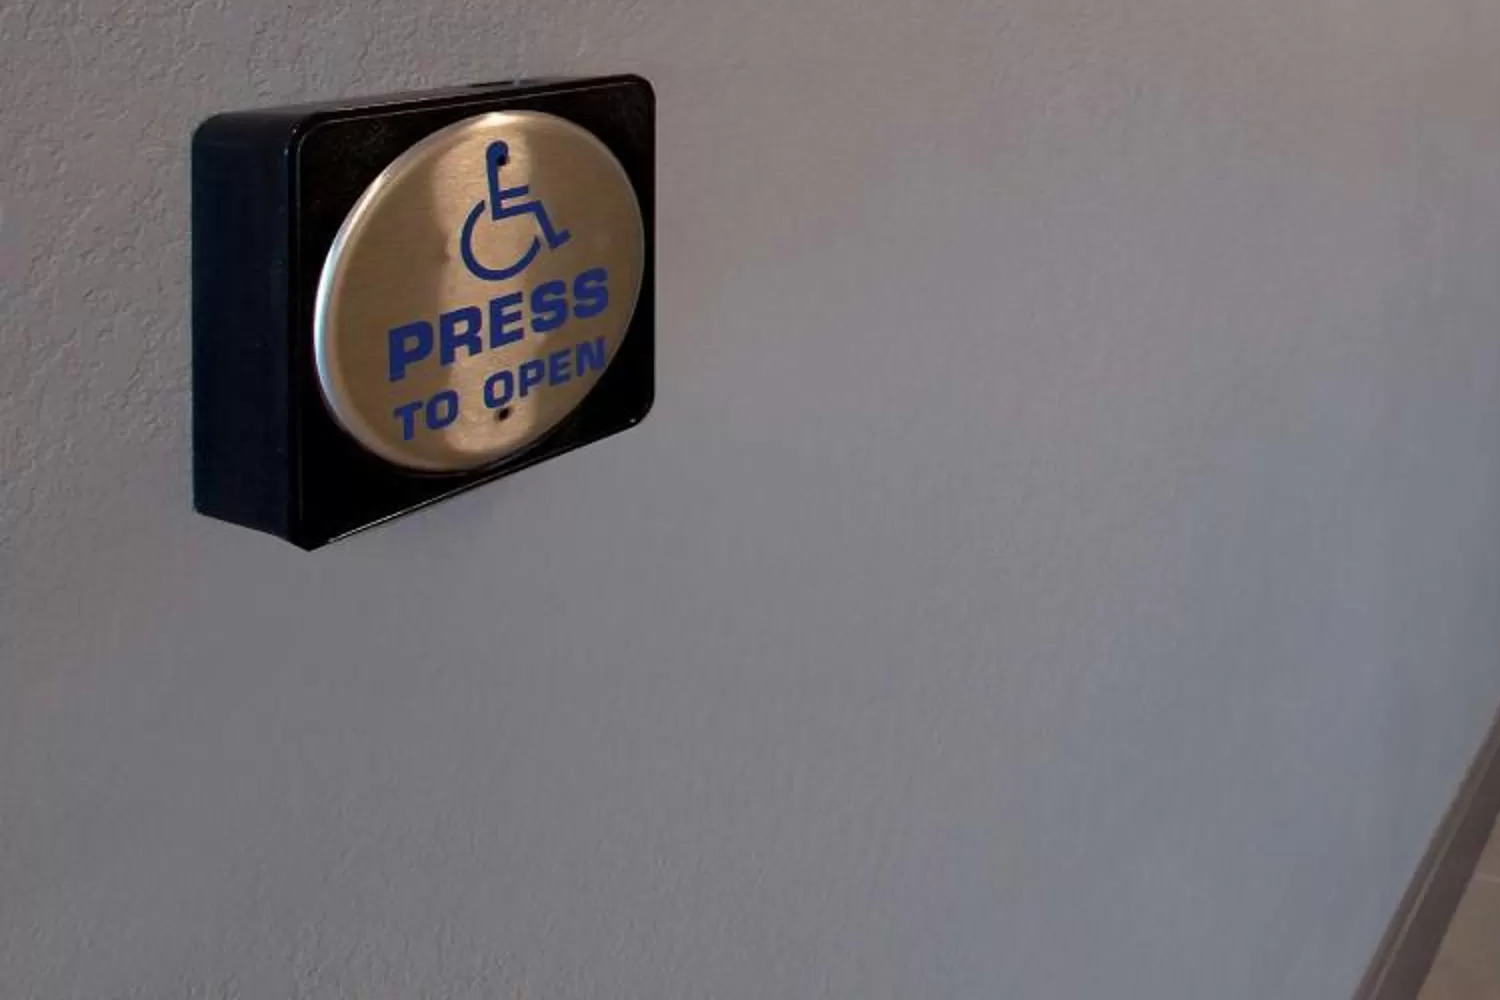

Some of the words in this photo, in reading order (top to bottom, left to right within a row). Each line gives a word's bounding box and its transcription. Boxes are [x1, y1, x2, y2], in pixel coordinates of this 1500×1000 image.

[388, 267, 610, 383] PRESS
[394, 389, 460, 441] TO
[483, 336, 607, 410] OPEN
